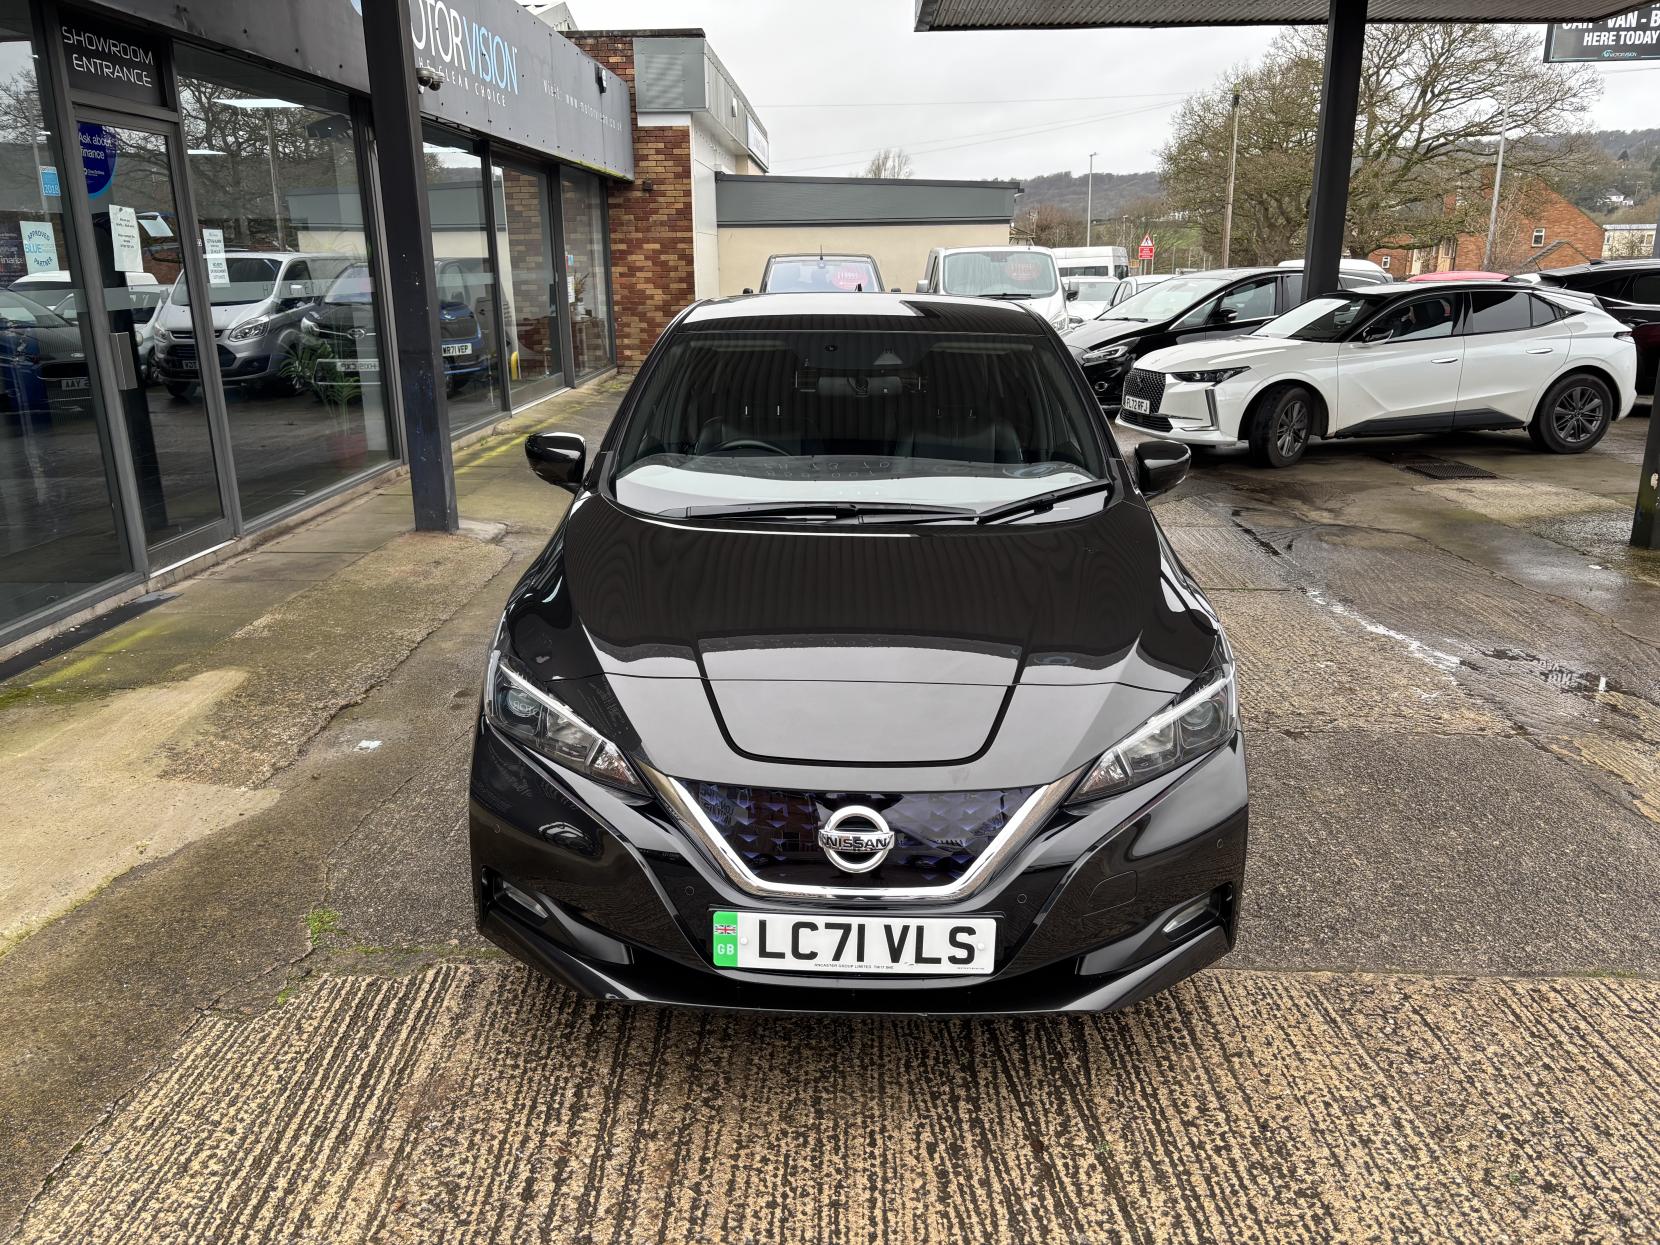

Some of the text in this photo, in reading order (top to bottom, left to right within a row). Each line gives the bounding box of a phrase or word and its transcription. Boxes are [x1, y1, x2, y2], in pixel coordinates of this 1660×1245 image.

[1607, 11, 1638, 28] VAN
[62, 26, 154, 66] SHOWROOM
[1583, 30, 1660, 46] HERE TODAY
[411, 0, 519, 95] OTORVISION
[73, 54, 152, 87] ENTRANCE
[475, 82, 506, 107] CHOICE
[79, 132, 112, 147] Ask about
[28, 230, 50, 241] APPROVED
[25, 243, 42, 254] BLUE
[33, 256, 53, 267] PARTNER
[826, 837, 887, 849] NISSAN
[717, 944, 735, 956] GB
[758, 919, 976, 965] LC71 VLS
